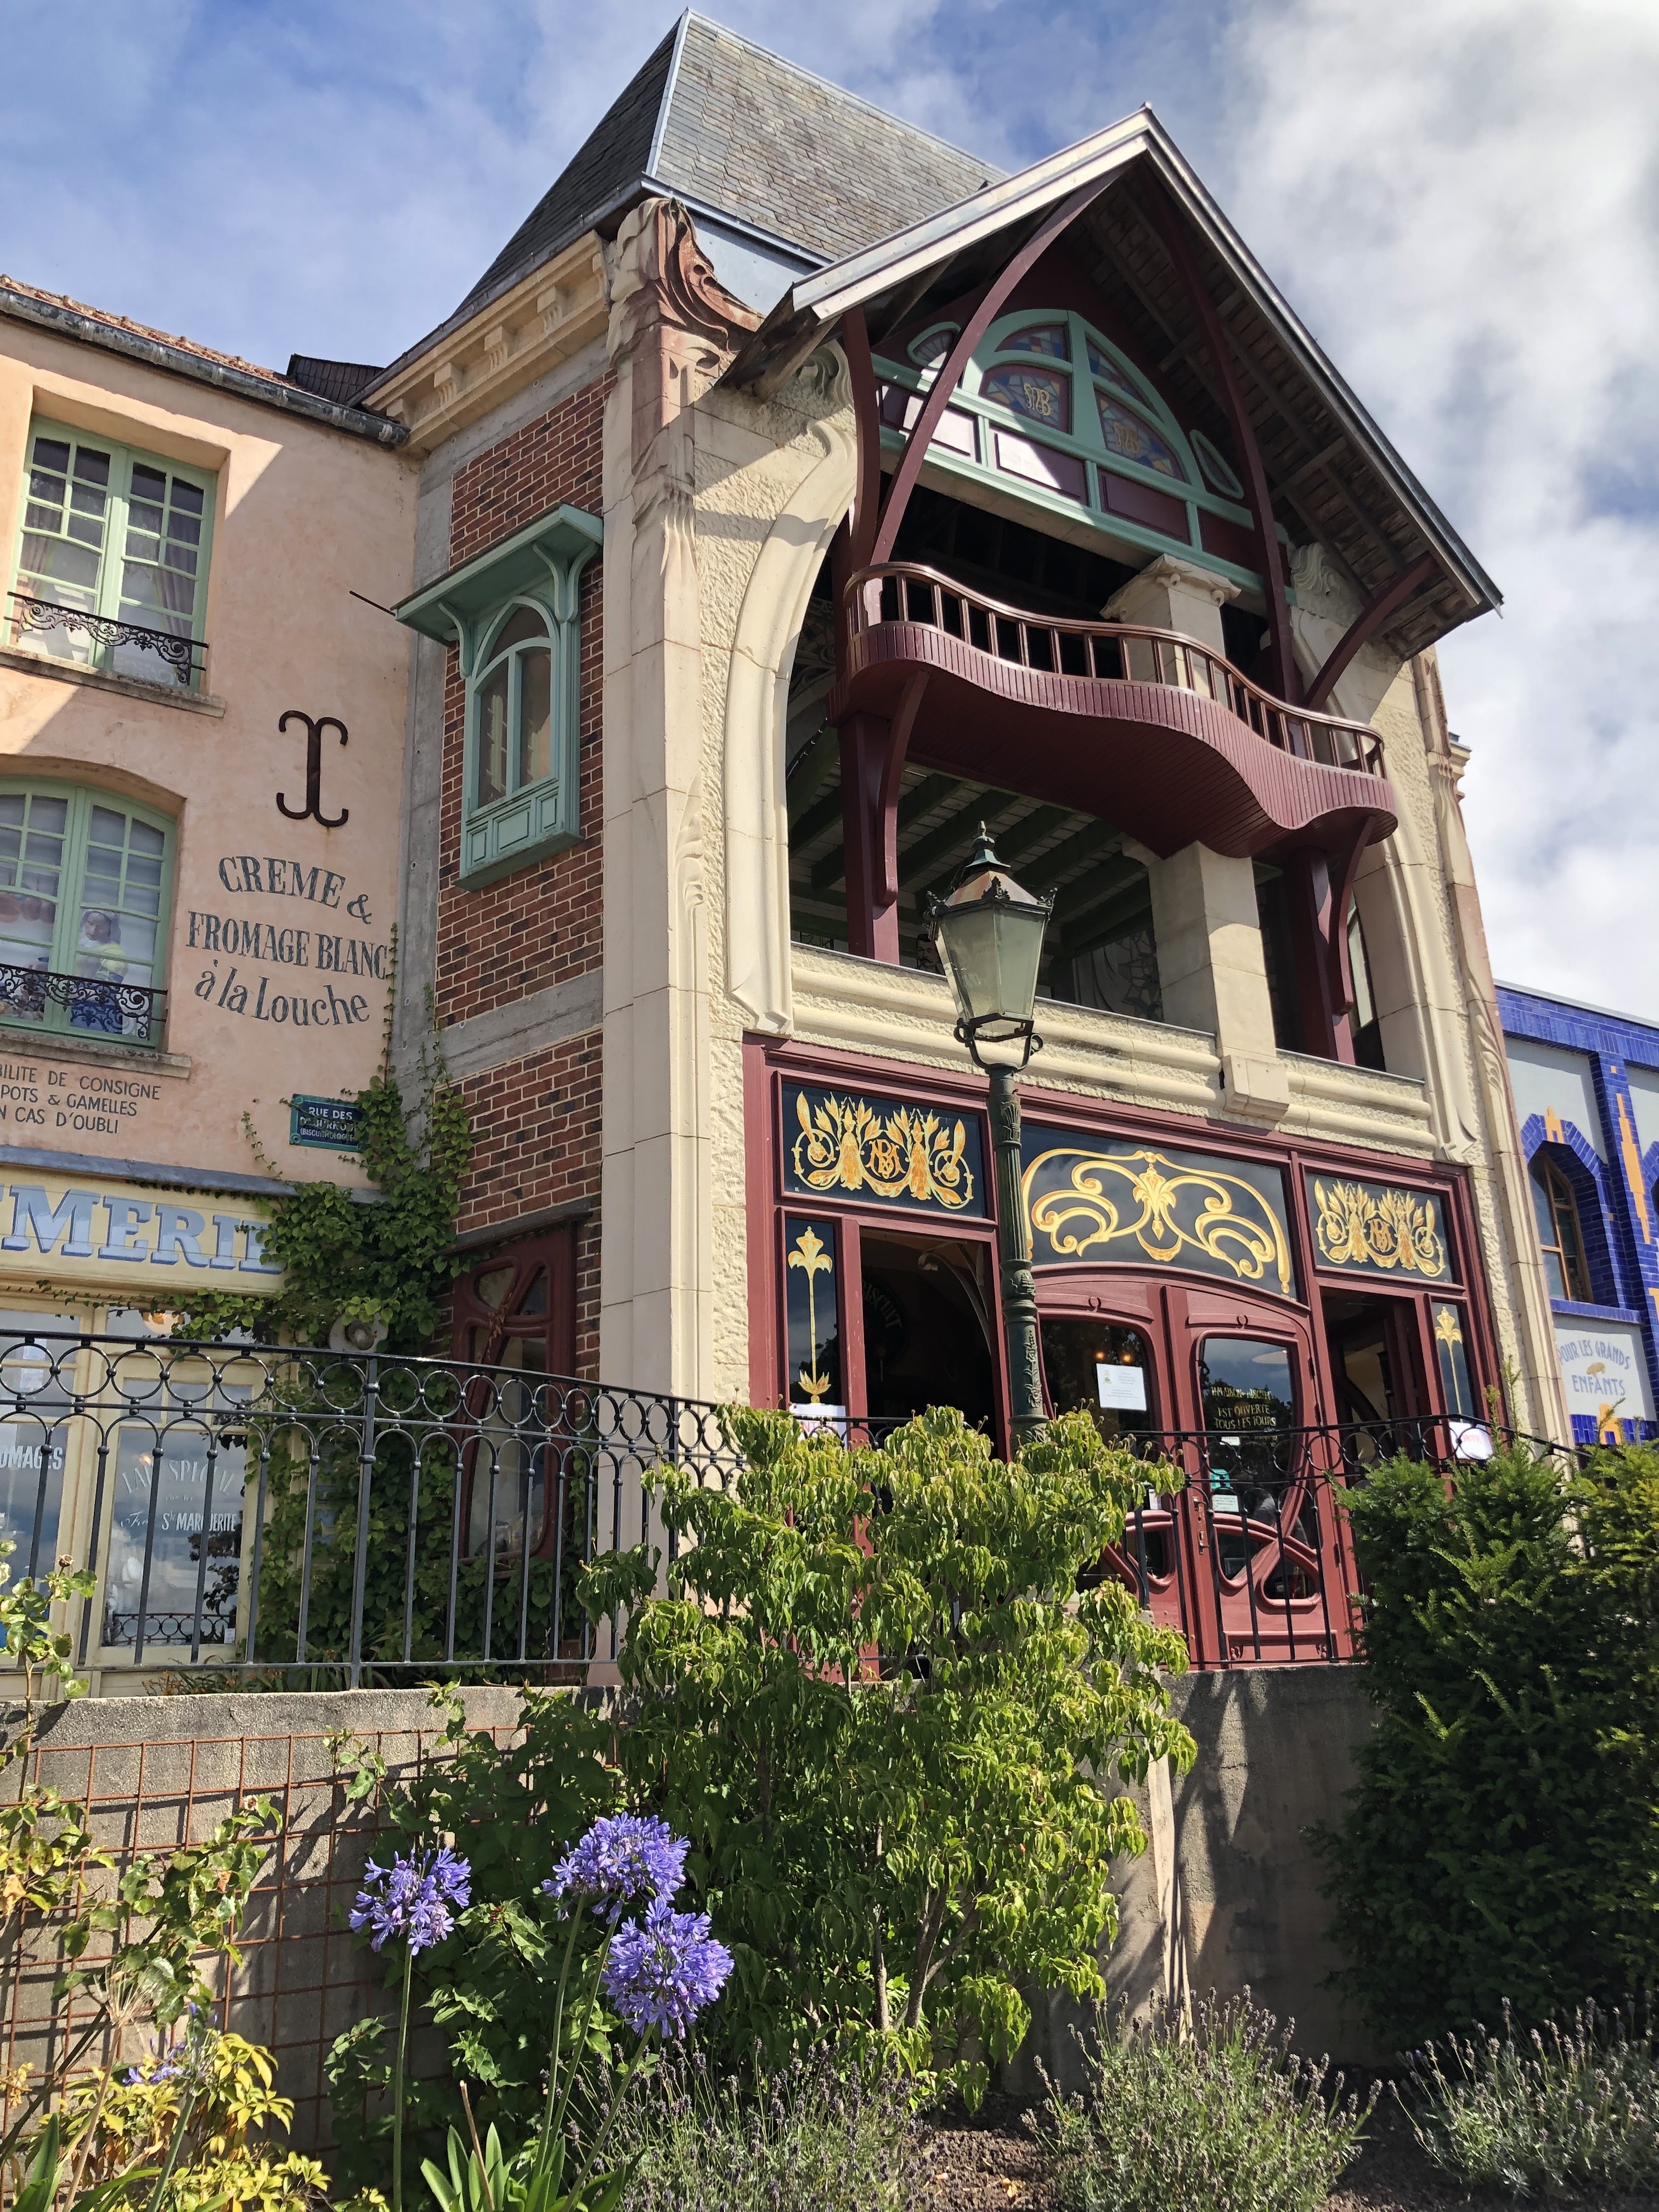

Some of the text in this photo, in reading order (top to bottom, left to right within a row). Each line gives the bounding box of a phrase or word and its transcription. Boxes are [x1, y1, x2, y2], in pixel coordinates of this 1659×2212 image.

[218, 856, 373, 925] CREME &
[185, 911, 388, 980] FROMAGE BLANC
[215, 966, 249, 1015] la
[251, 976, 370, 1026] Louche
[0, 1064, 161, 1101] ILITE DE CONSIGNE
[1, 1084, 138, 1117] POTS & GAMELLES
[308, 1107, 353, 1121] RUE DES
[15, 1107, 46, 1125] CAS
[56, 1111, 119, 1134] D'OUBLI
[0, 1183, 285, 1276] MERIE
[1557, 1339, 1630, 1370] POUR LES GRANDS
[1571, 1374, 1626, 1396] ENFANTS
[1214, 1417, 1235, 1430] TOUS
[1234, 1403, 1271, 1416] OUVERTE
